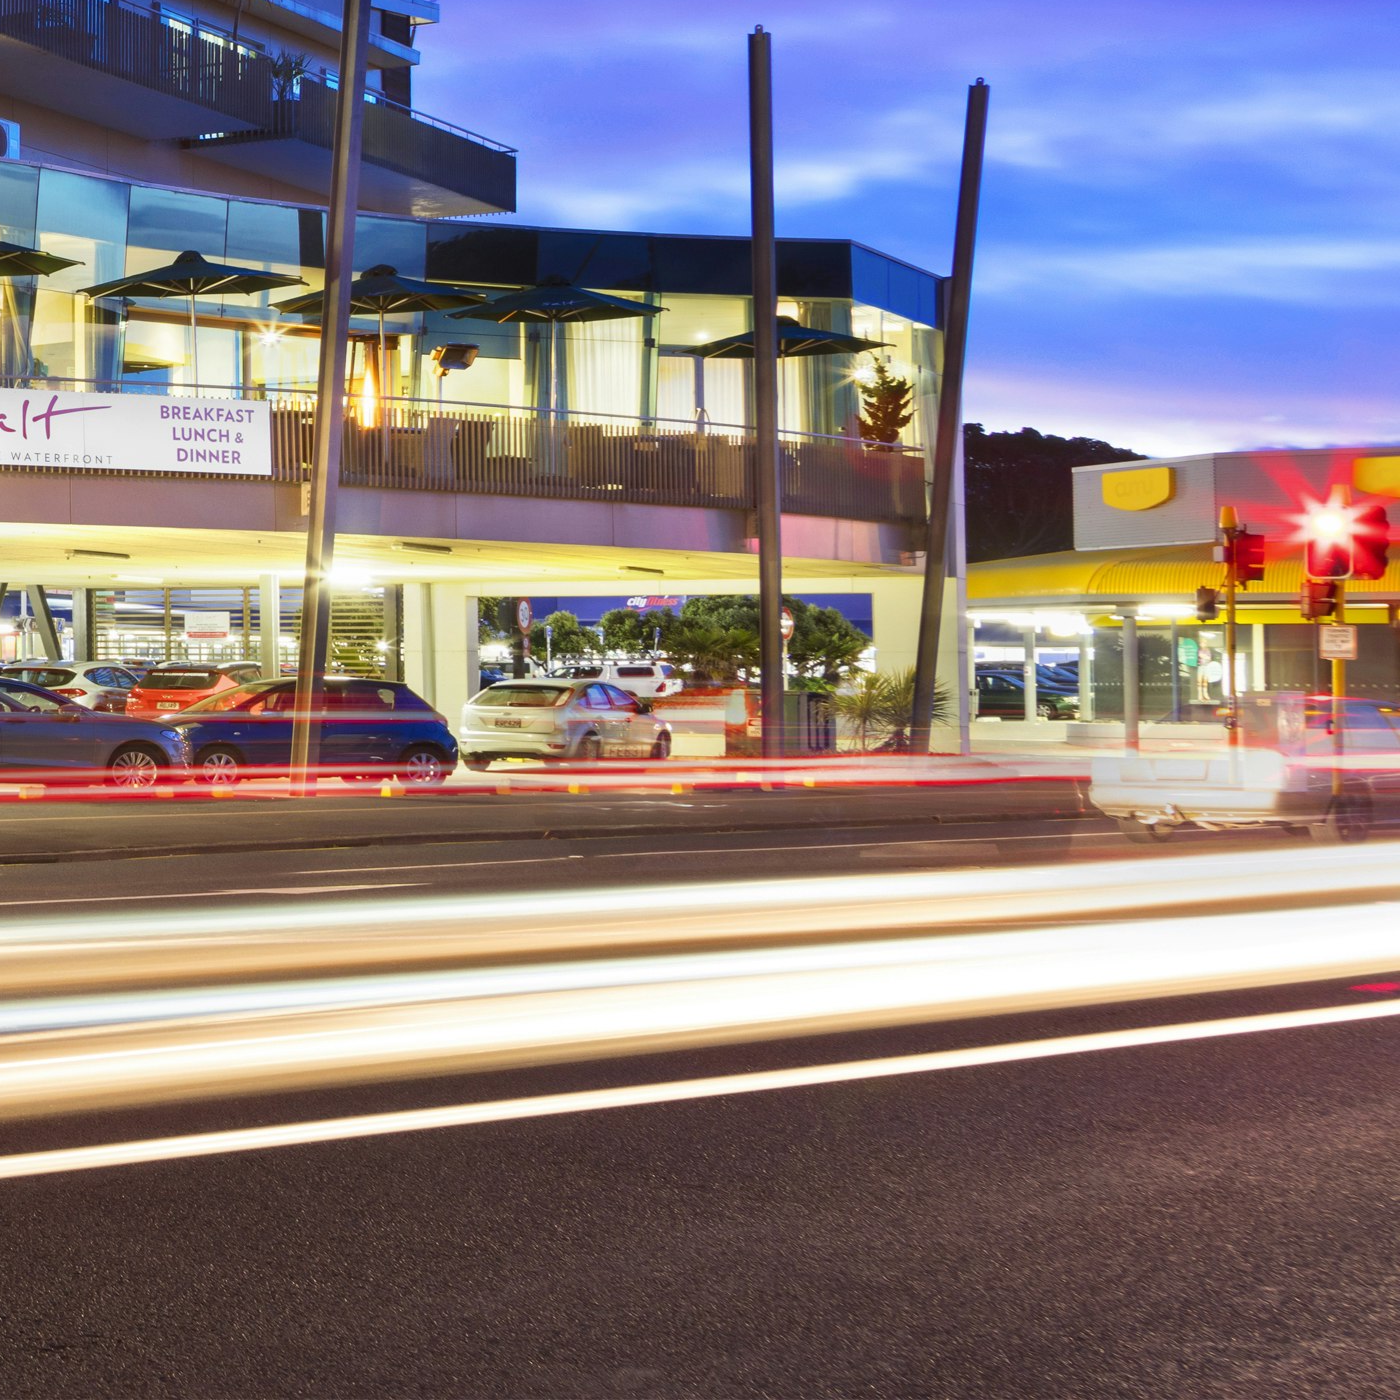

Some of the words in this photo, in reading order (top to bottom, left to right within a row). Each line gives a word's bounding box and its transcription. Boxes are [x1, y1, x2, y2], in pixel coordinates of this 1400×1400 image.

[160, 405, 255, 423] BREAKFAST
[172, 426, 230, 443] LUNCH
[234, 432, 244, 444] &
[11, 451, 114, 465] WATERFRONT
[176, 447, 242, 464] DINNER
